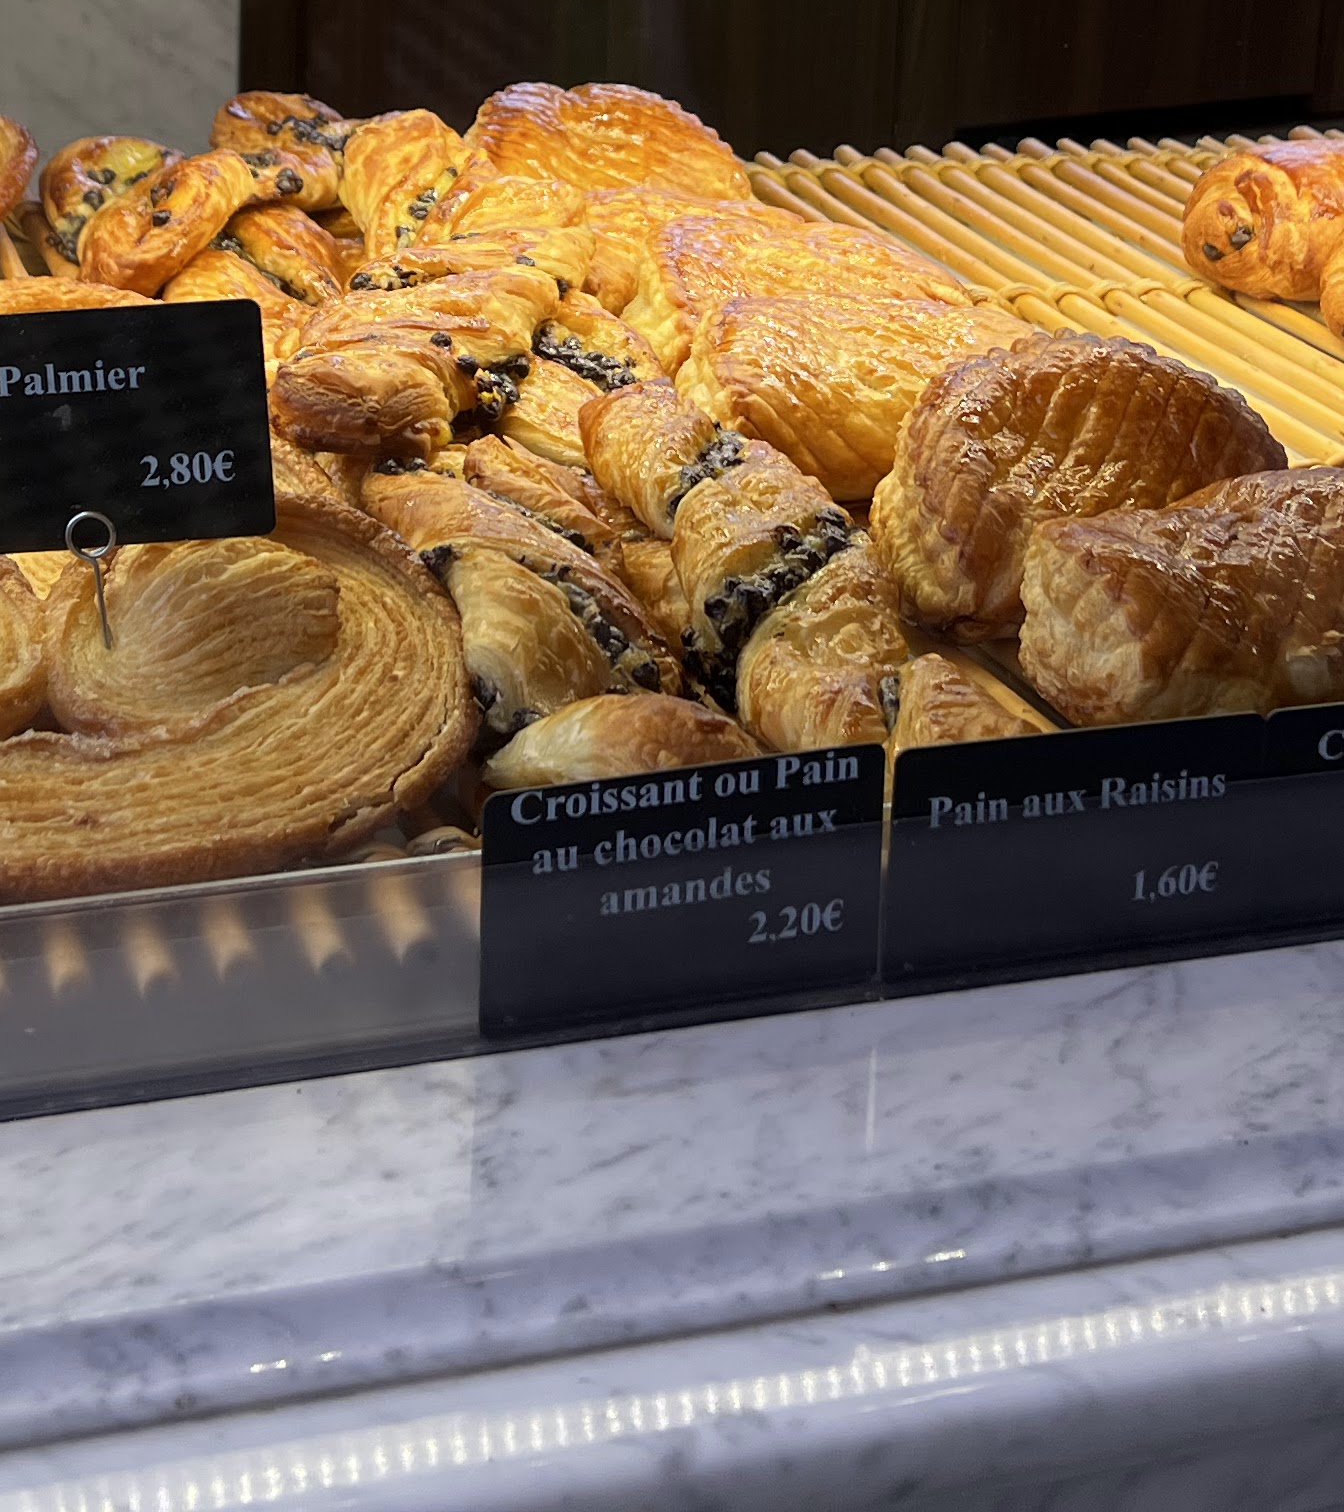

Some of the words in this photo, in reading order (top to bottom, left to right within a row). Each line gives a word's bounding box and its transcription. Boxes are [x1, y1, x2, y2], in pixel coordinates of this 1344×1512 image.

[139, 449, 236, 489] 2,80€
[511, 771, 703, 826] Croissant
[714, 770, 760, 798] ou
[776, 751, 859, 788] Pain
[928, 791, 1008, 830] Pain
[1022, 788, 1088, 818] aux
[1099, 769, 1228, 811] Raisins
[532, 844, 578, 875] au
[593, 816, 757, 866] chocolat
[769, 808, 837, 839] aux
[600, 865, 772, 916] amandes
[1130, 861, 1219, 903] 1,60€
